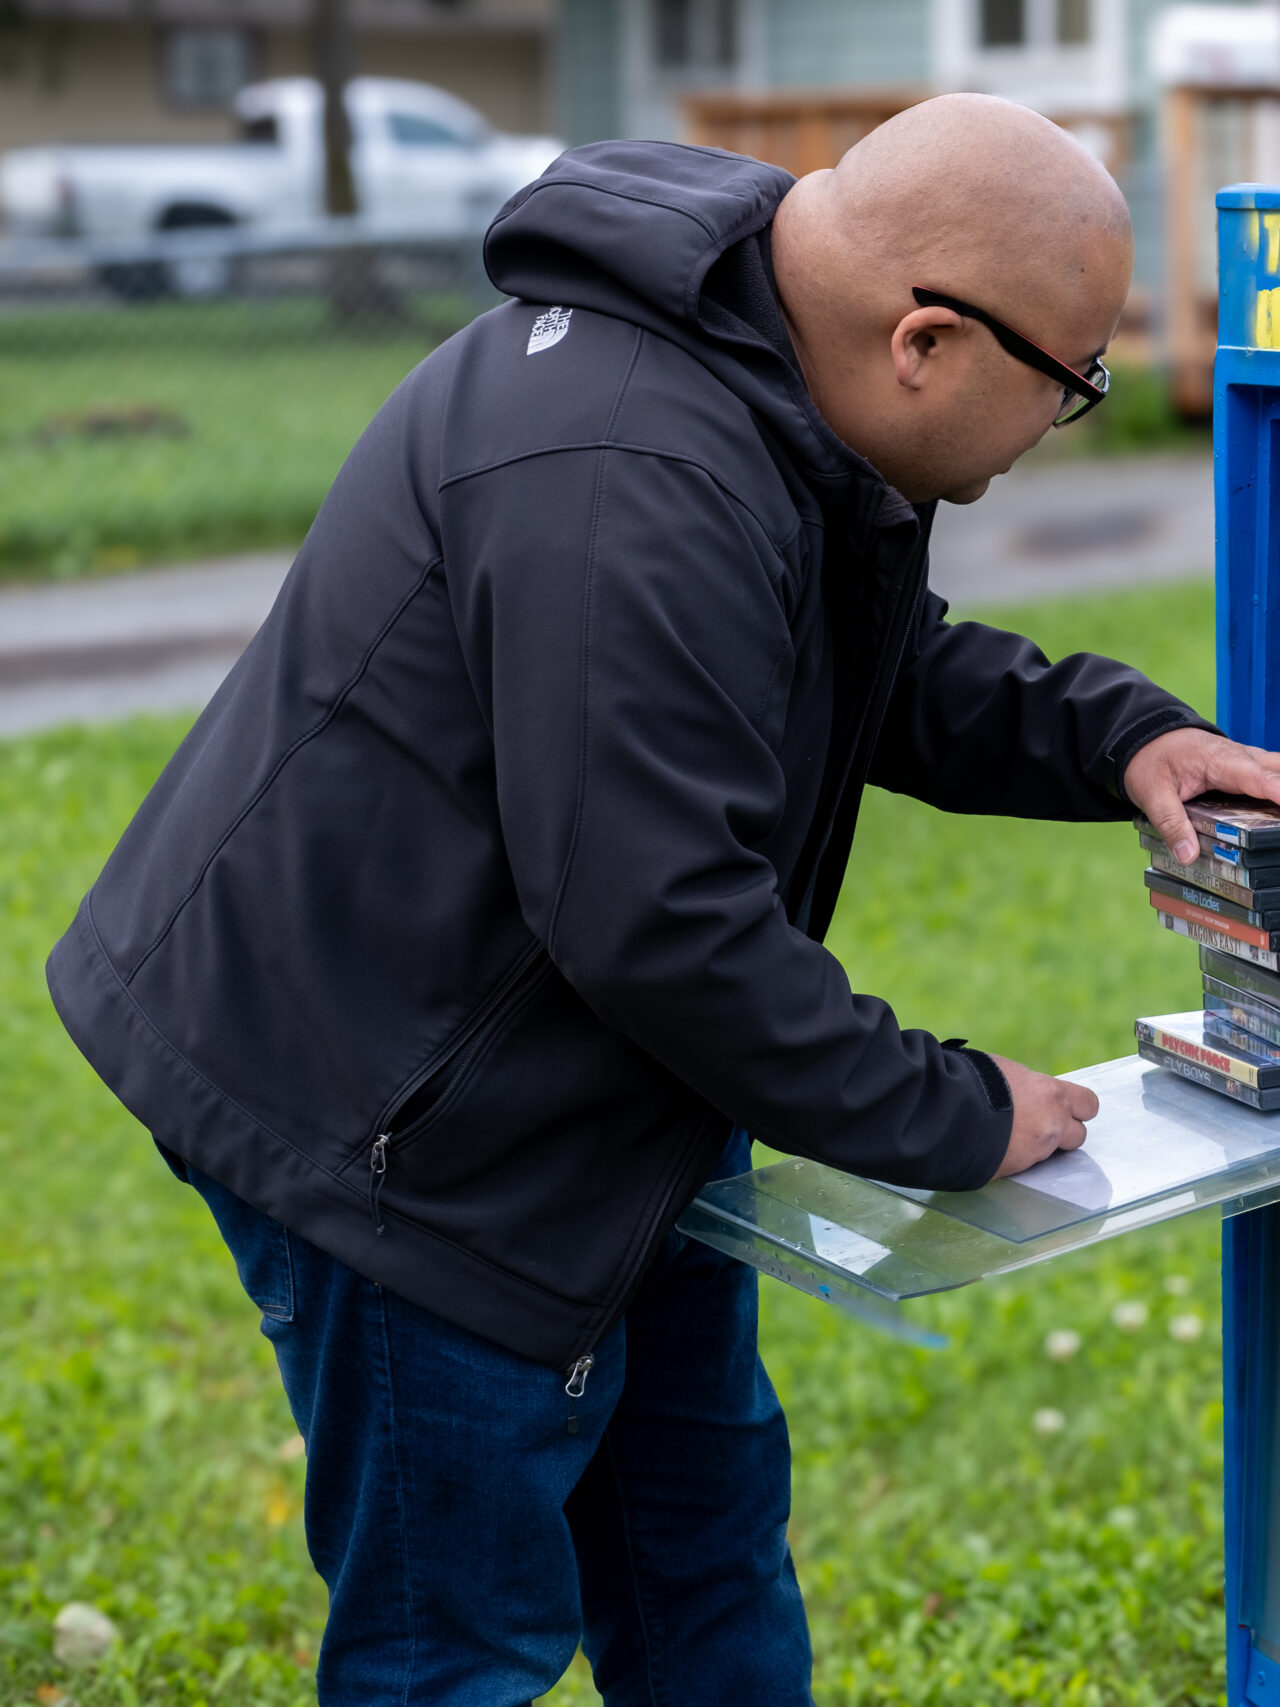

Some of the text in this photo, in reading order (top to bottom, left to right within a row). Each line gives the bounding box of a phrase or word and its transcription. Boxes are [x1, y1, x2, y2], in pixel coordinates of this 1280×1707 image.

[532, 313, 548, 337] FACE
[543, 306, 563, 334] ORTH
[557, 308, 573, 331] THE
[1183, 886, 1199, 904] Hello
[1193, 870, 1234, 896] GENTLEMEN
[1187, 923, 1218, 947] WAGONS
[1220, 934, 1241, 955] EAST!
[1162, 1033, 1231, 1073] PSYCHIC FORCE
[1163, 1057, 1212, 1084] FLYBOYS
